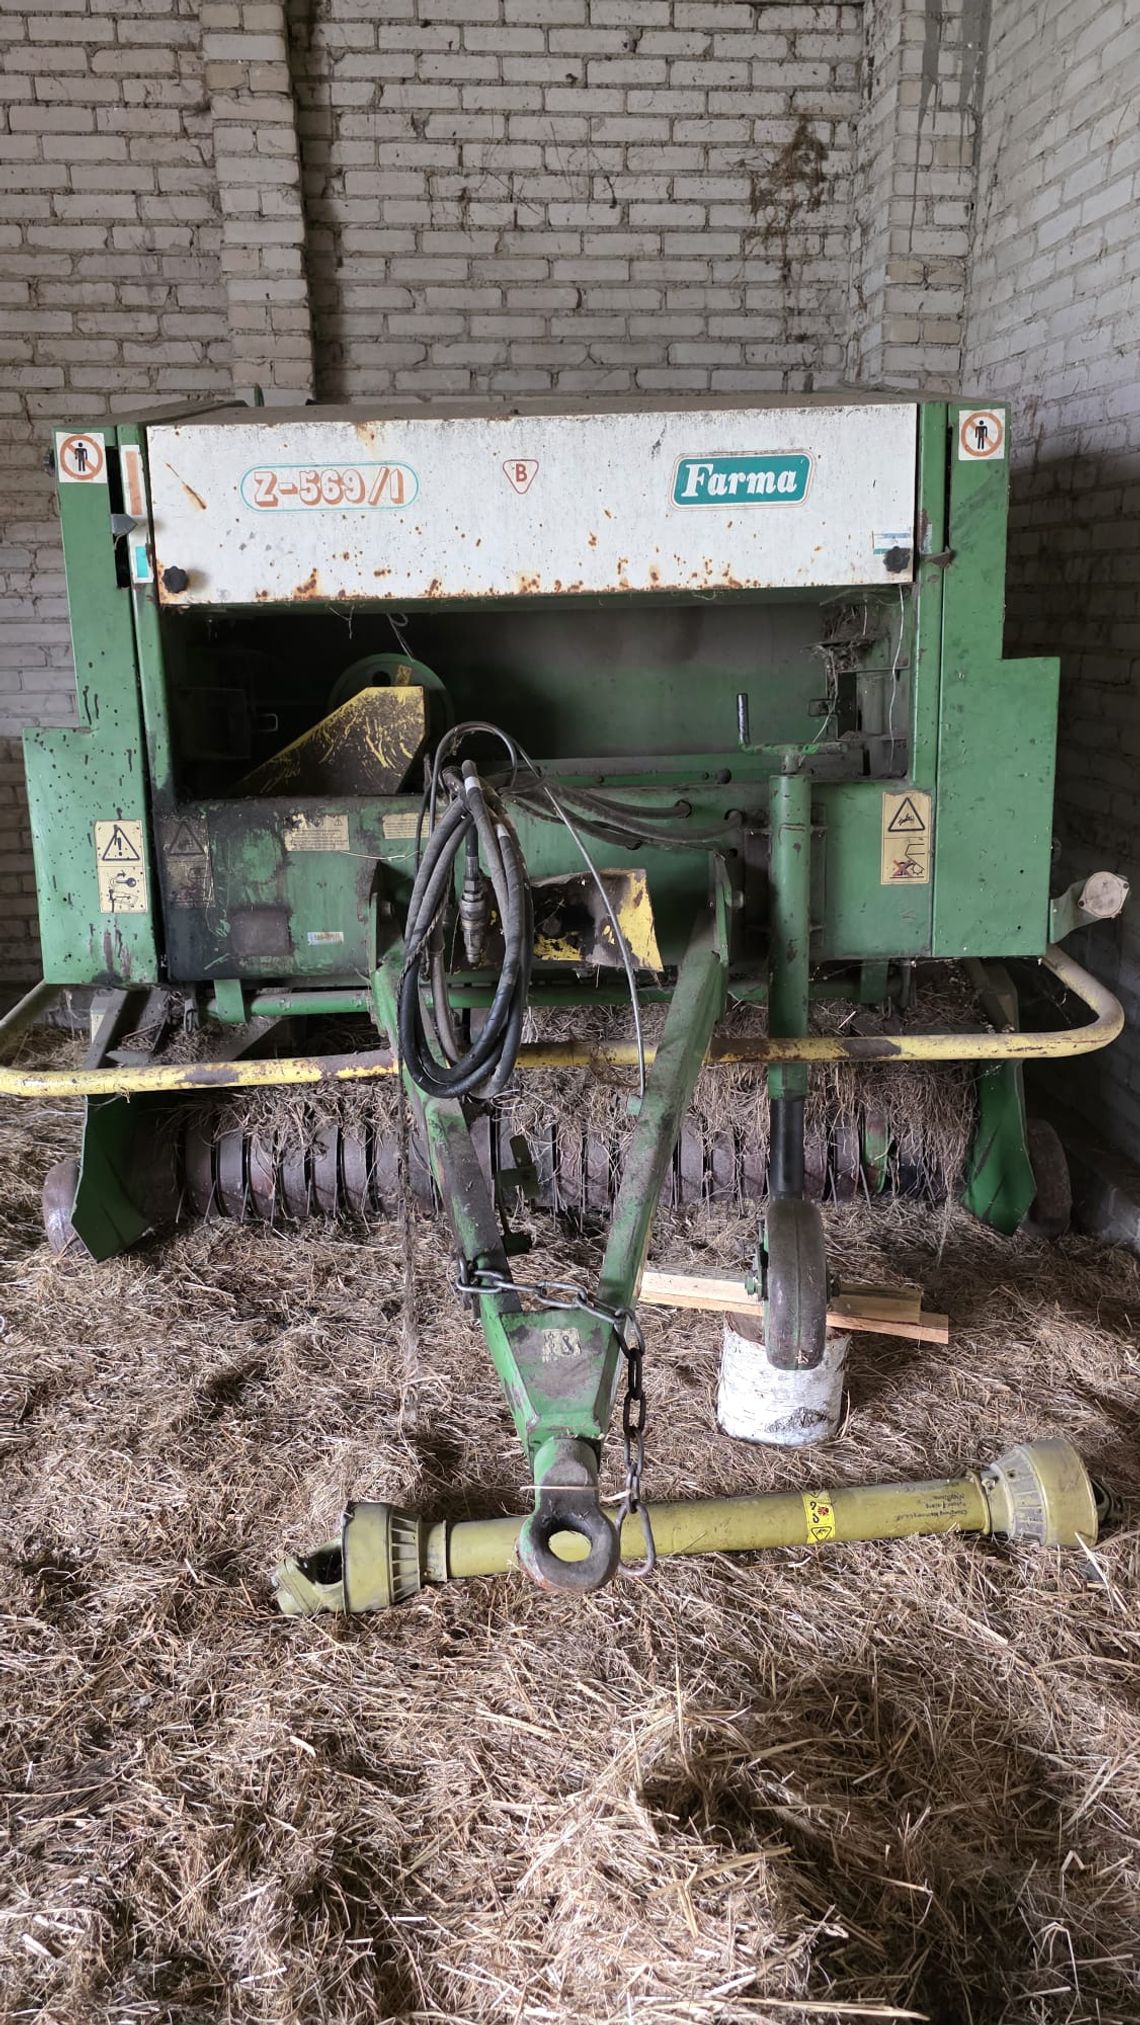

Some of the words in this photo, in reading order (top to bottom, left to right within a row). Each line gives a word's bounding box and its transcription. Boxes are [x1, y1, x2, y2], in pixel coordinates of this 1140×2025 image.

[254, 466, 405, 507] Z-569/1
[515, 463, 528, 482] B
[681, 463, 798, 498] Farma
